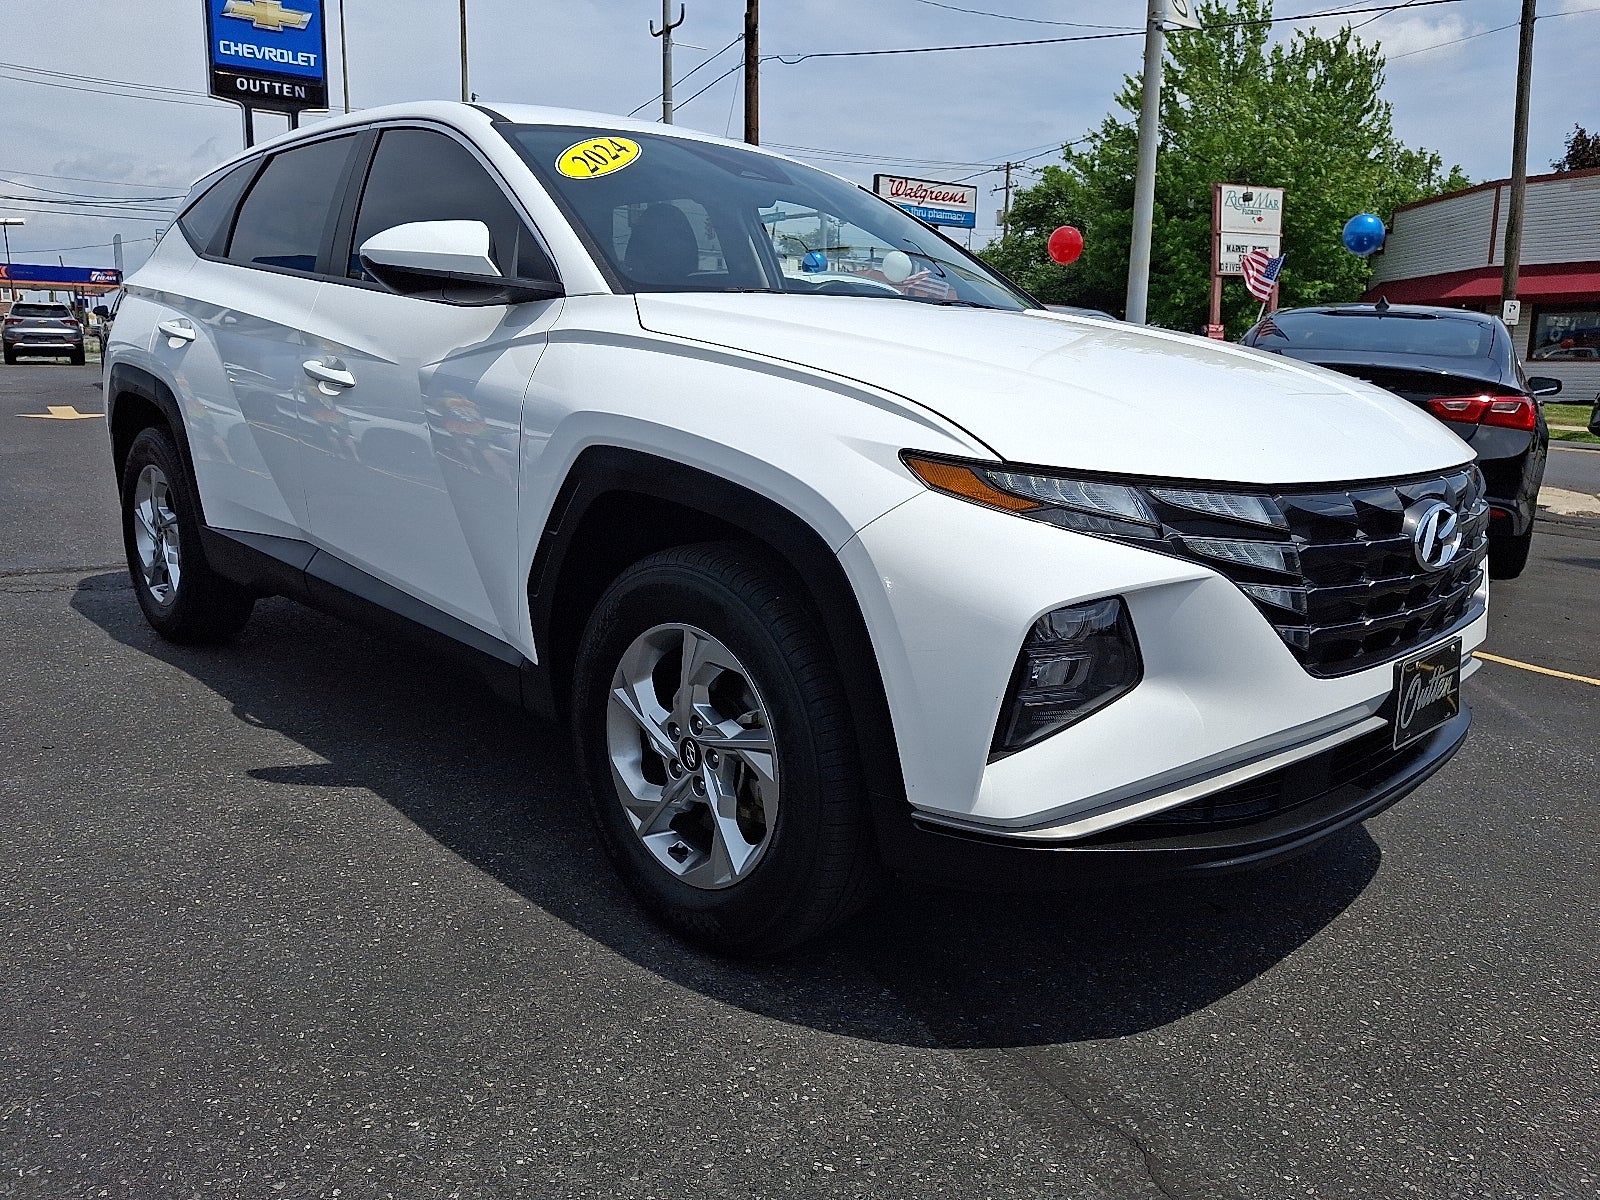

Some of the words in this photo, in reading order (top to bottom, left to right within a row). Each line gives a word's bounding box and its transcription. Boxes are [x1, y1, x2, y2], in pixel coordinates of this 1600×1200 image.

[219, 40, 317, 67] CHEVROLET
[236, 77, 306, 98] OUTTEN
[571, 138, 630, 174] 2024
[888, 179, 968, 205] Walgreens
[910, 207, 927, 217] thru
[928, 209, 966, 223] pharmacy
